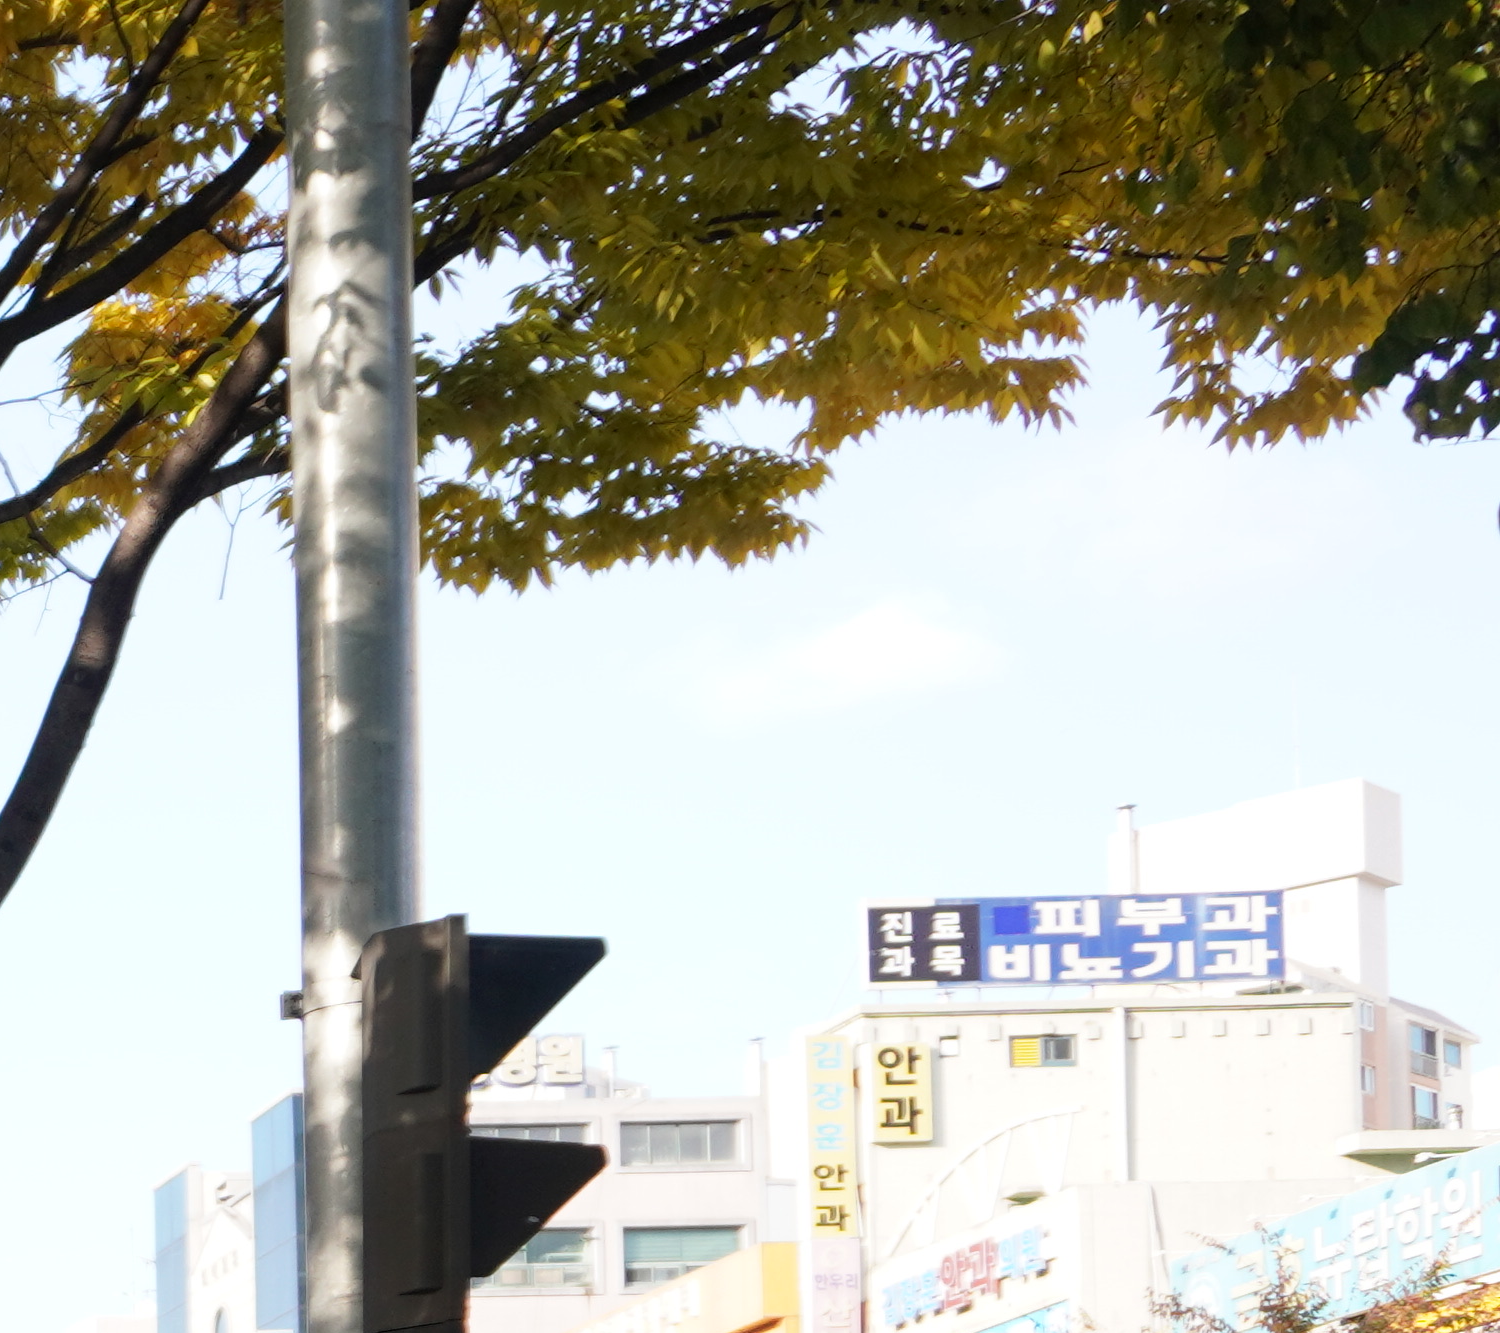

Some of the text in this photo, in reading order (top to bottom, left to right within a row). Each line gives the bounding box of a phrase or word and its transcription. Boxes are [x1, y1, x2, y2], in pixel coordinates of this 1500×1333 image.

[880, 912, 964, 940] 진료
[1032, 896, 1277, 934] 피부과
[880, 947, 965, 976] 과목
[989, 940, 1279, 981] 비뇨기과
[878, 1046, 923, 1136] 안과
[815, 1273, 858, 1289] 한우리
